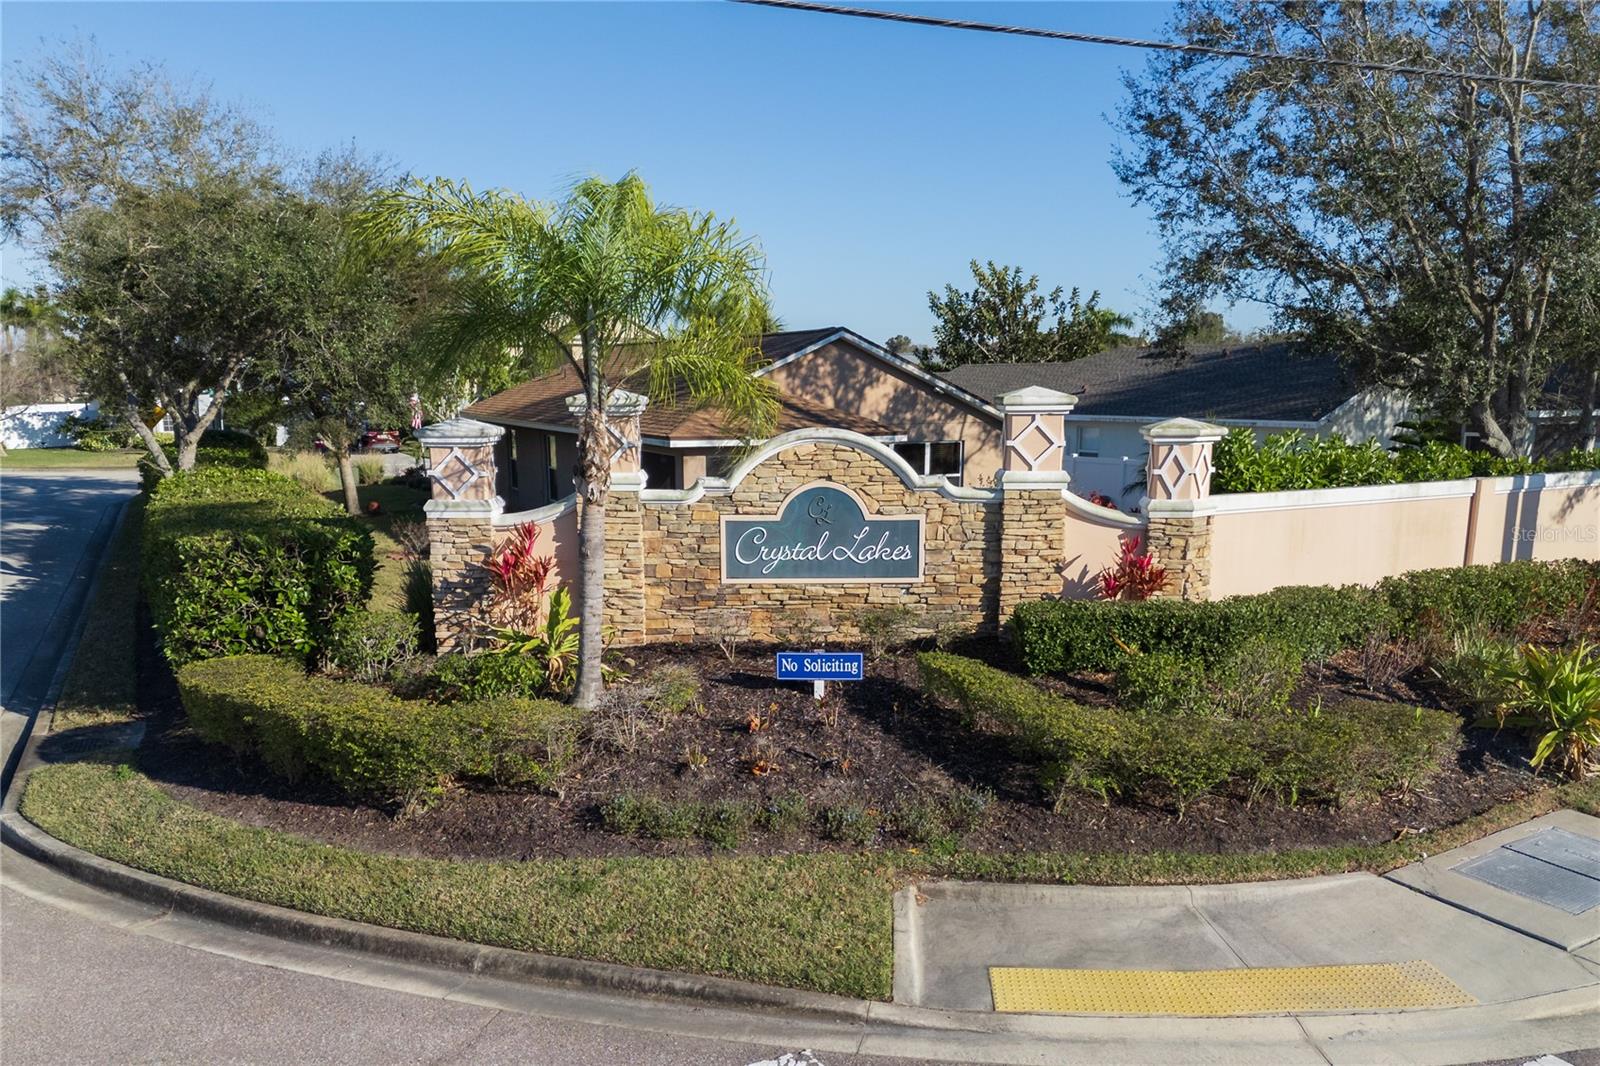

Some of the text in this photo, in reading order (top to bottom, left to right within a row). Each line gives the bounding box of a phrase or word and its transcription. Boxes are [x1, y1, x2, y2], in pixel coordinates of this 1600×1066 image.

[735, 526, 912, 574] Crystal Lakes
[781, 658, 859, 675] No Soliciting
